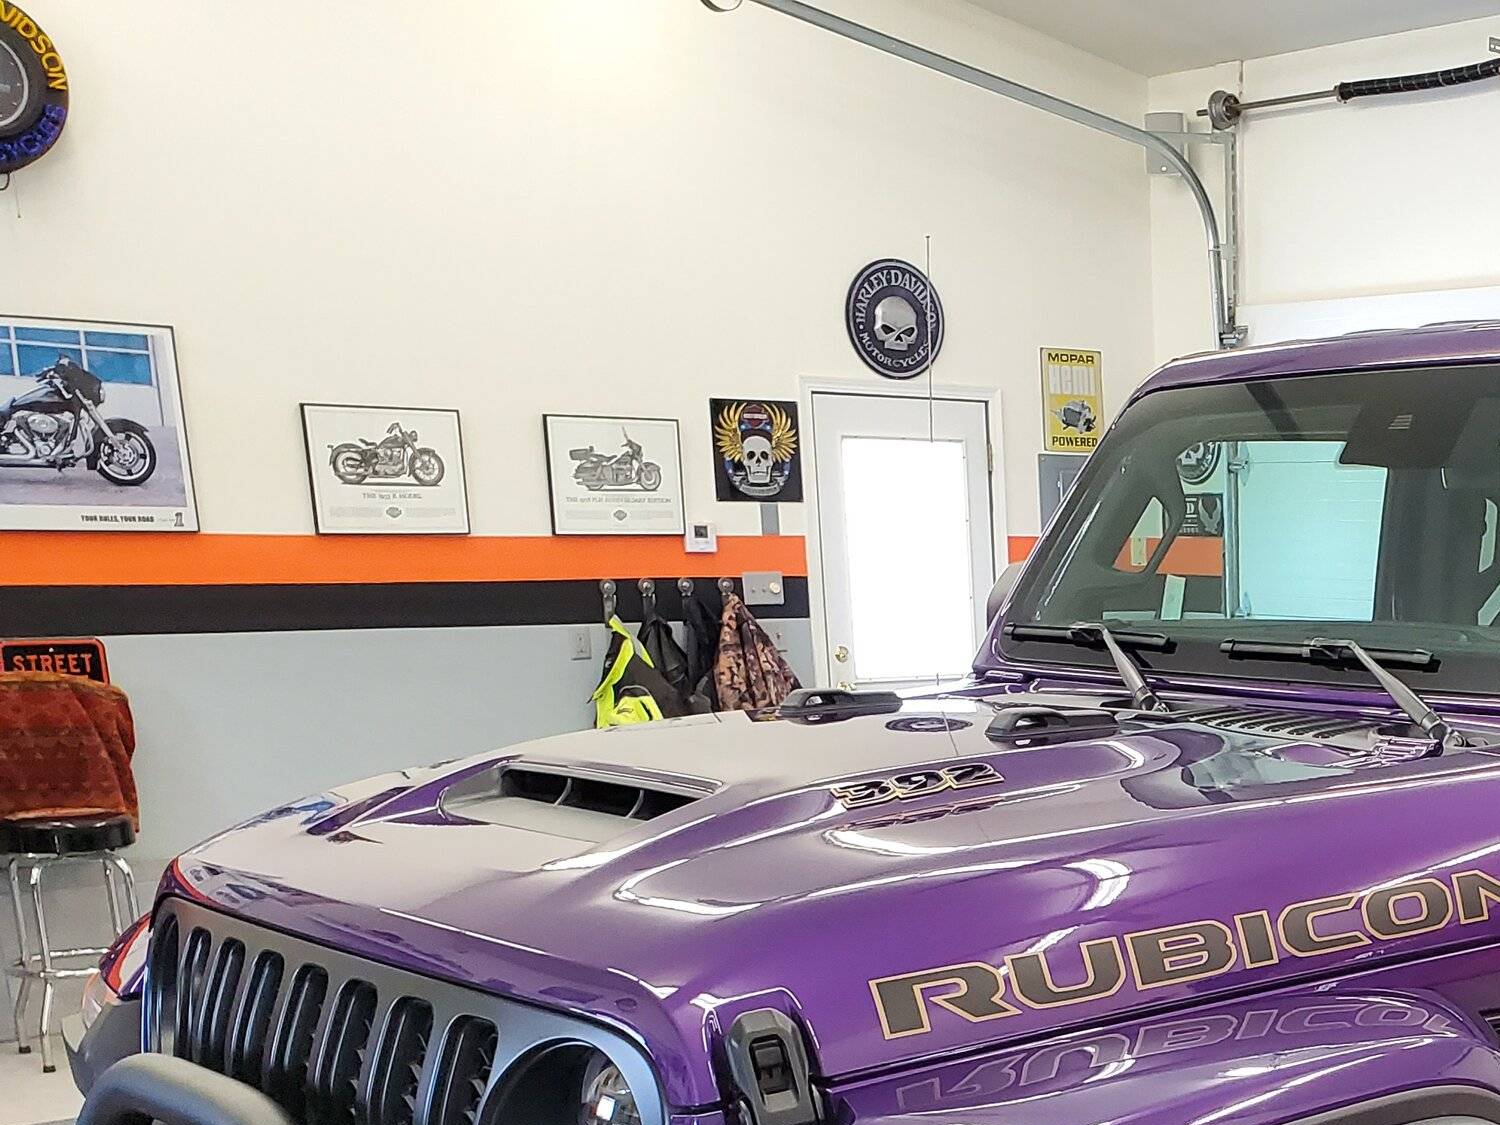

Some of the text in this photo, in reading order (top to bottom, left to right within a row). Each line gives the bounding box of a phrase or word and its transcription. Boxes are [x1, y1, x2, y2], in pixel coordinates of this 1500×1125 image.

[1047, 352, 1095, 365] MOPAR
[1052, 436, 1098, 447] POWERED
[12, 653, 92, 674] STREET
[829, 763, 1005, 810] 392
